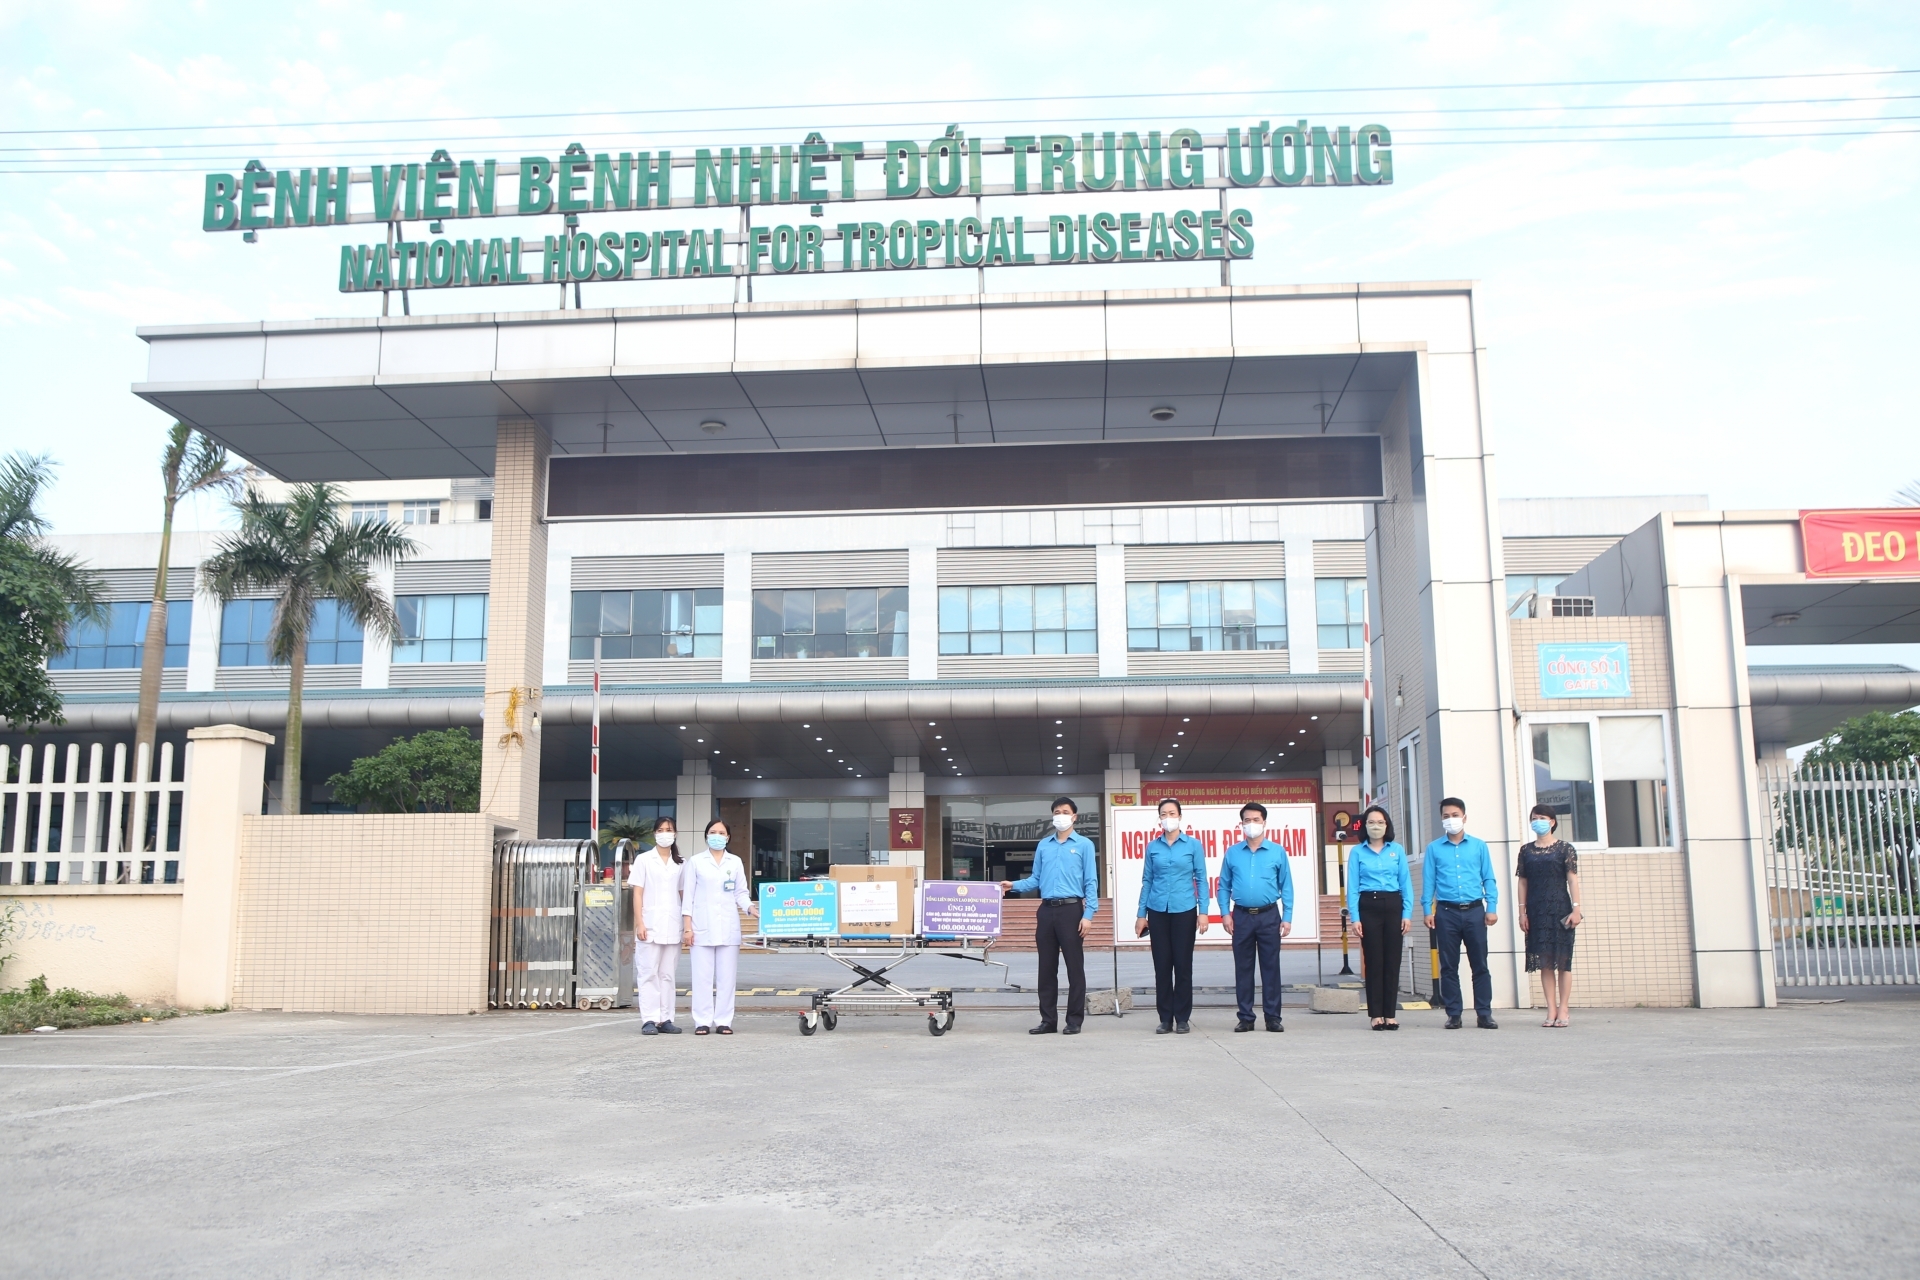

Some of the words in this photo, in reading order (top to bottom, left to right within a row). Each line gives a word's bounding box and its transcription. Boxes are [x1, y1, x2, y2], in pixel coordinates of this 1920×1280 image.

[203, 159, 350, 243] BỆNH
[371, 149, 497, 234] VIỆN
[518, 142, 671, 228] BỆNH
[695, 132, 863, 218] NHIỆT
[883, 123, 982, 199] ĐỚI
[1005, 128, 1205, 193] TRUNG
[1227, 119, 1393, 187] ƯƠNG
[340, 236, 529, 291] NATIONAL
[543, 228, 732, 282] HOSPITAL
[749, 224, 824, 274] FOR
[837, 216, 1034, 271] TROPICAL
[1049, 208, 1254, 262] DISEASES
[1842, 530, 1906, 563] ĐEO
[1590, 654, 1609, 675] SỐ
[1613, 660, 1621, 674] 1
[1564, 679, 1598, 690] GATE
[1602, 679, 1608, 690] 1
[797, 899, 813, 908] TRỢ
[965, 904, 976, 913] HỘ
[773, 908, 824, 917] 50.000.000đ
